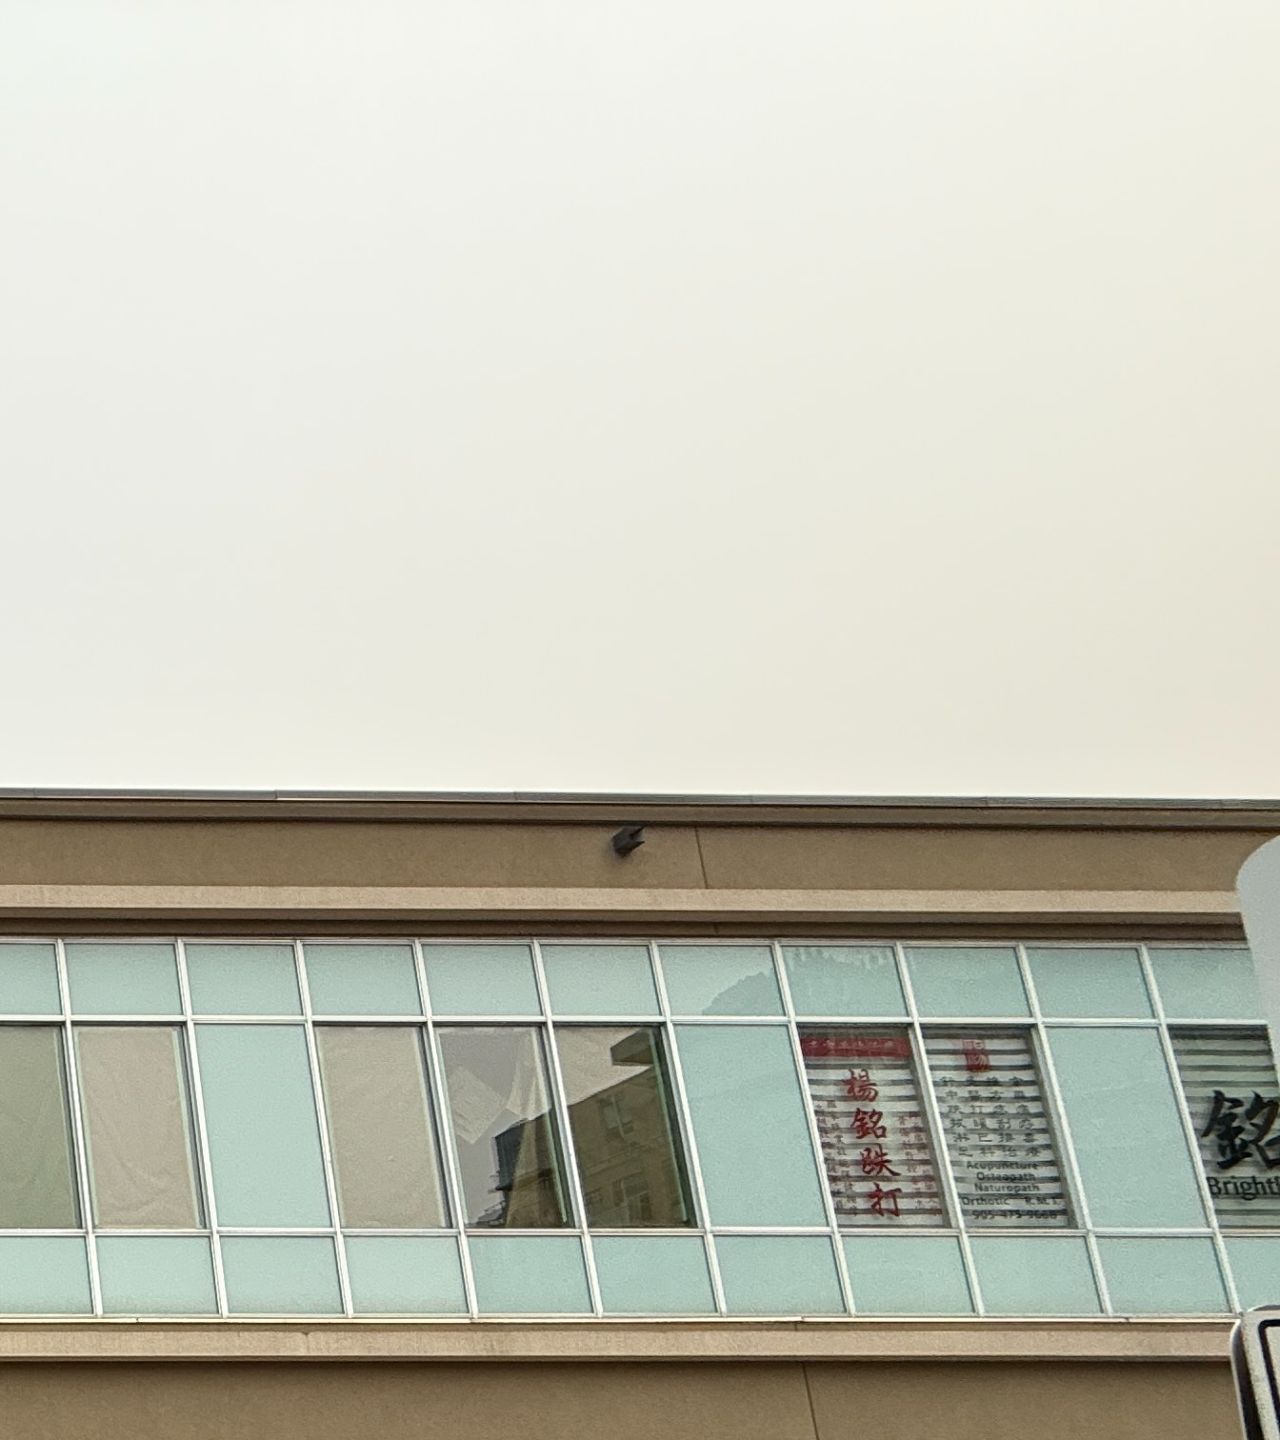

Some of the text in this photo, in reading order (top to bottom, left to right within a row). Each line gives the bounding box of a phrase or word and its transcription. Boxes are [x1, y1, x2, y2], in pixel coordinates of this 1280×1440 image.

[974, 1183, 1040, 1194] Naturopath
[1206, 1175, 1280, 1201] Bright
[962, 1197, 1010, 1206] Orthotic
